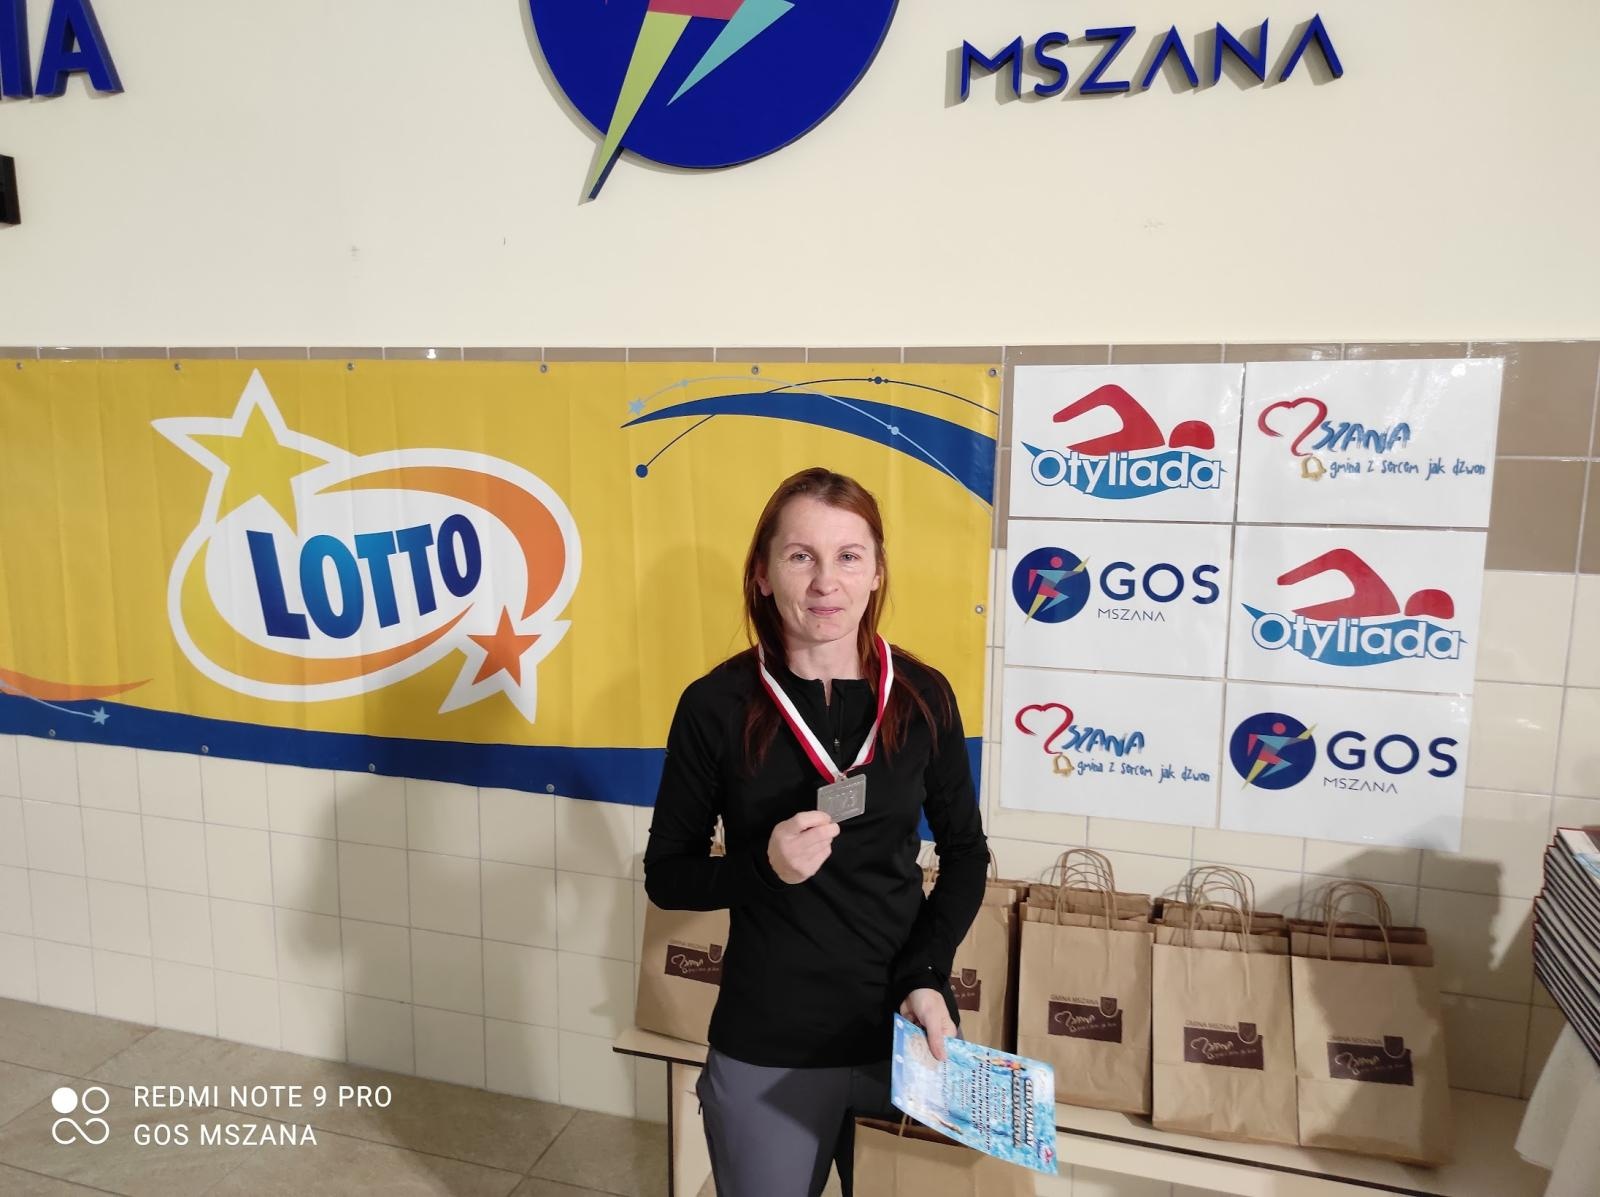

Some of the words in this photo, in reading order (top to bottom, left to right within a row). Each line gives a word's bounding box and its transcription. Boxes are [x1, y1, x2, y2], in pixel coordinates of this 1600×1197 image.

[960, 13, 1344, 102] MSZANA
[1031, 449, 1222, 494] Otyliada
[1330, 458, 1361, 478] gmina
[1381, 458, 1419, 475] sercem
[1425, 457, 1446, 481] jak
[1452, 457, 1486, 476] dzwon
[246, 513, 482, 640] LOTTO
[1100, 561, 1220, 605] GOS
[1098, 607, 1165, 622] MSZANA
[1251, 612, 1462, 661] Otyliada
[1077, 758, 1103, 776] gmina
[1120, 762, 1153, 777] sercem
[1158, 763, 1175, 784] jak
[1326, 730, 1458, 779] GOS
[1323, 776, 1398, 794] MSZANA
